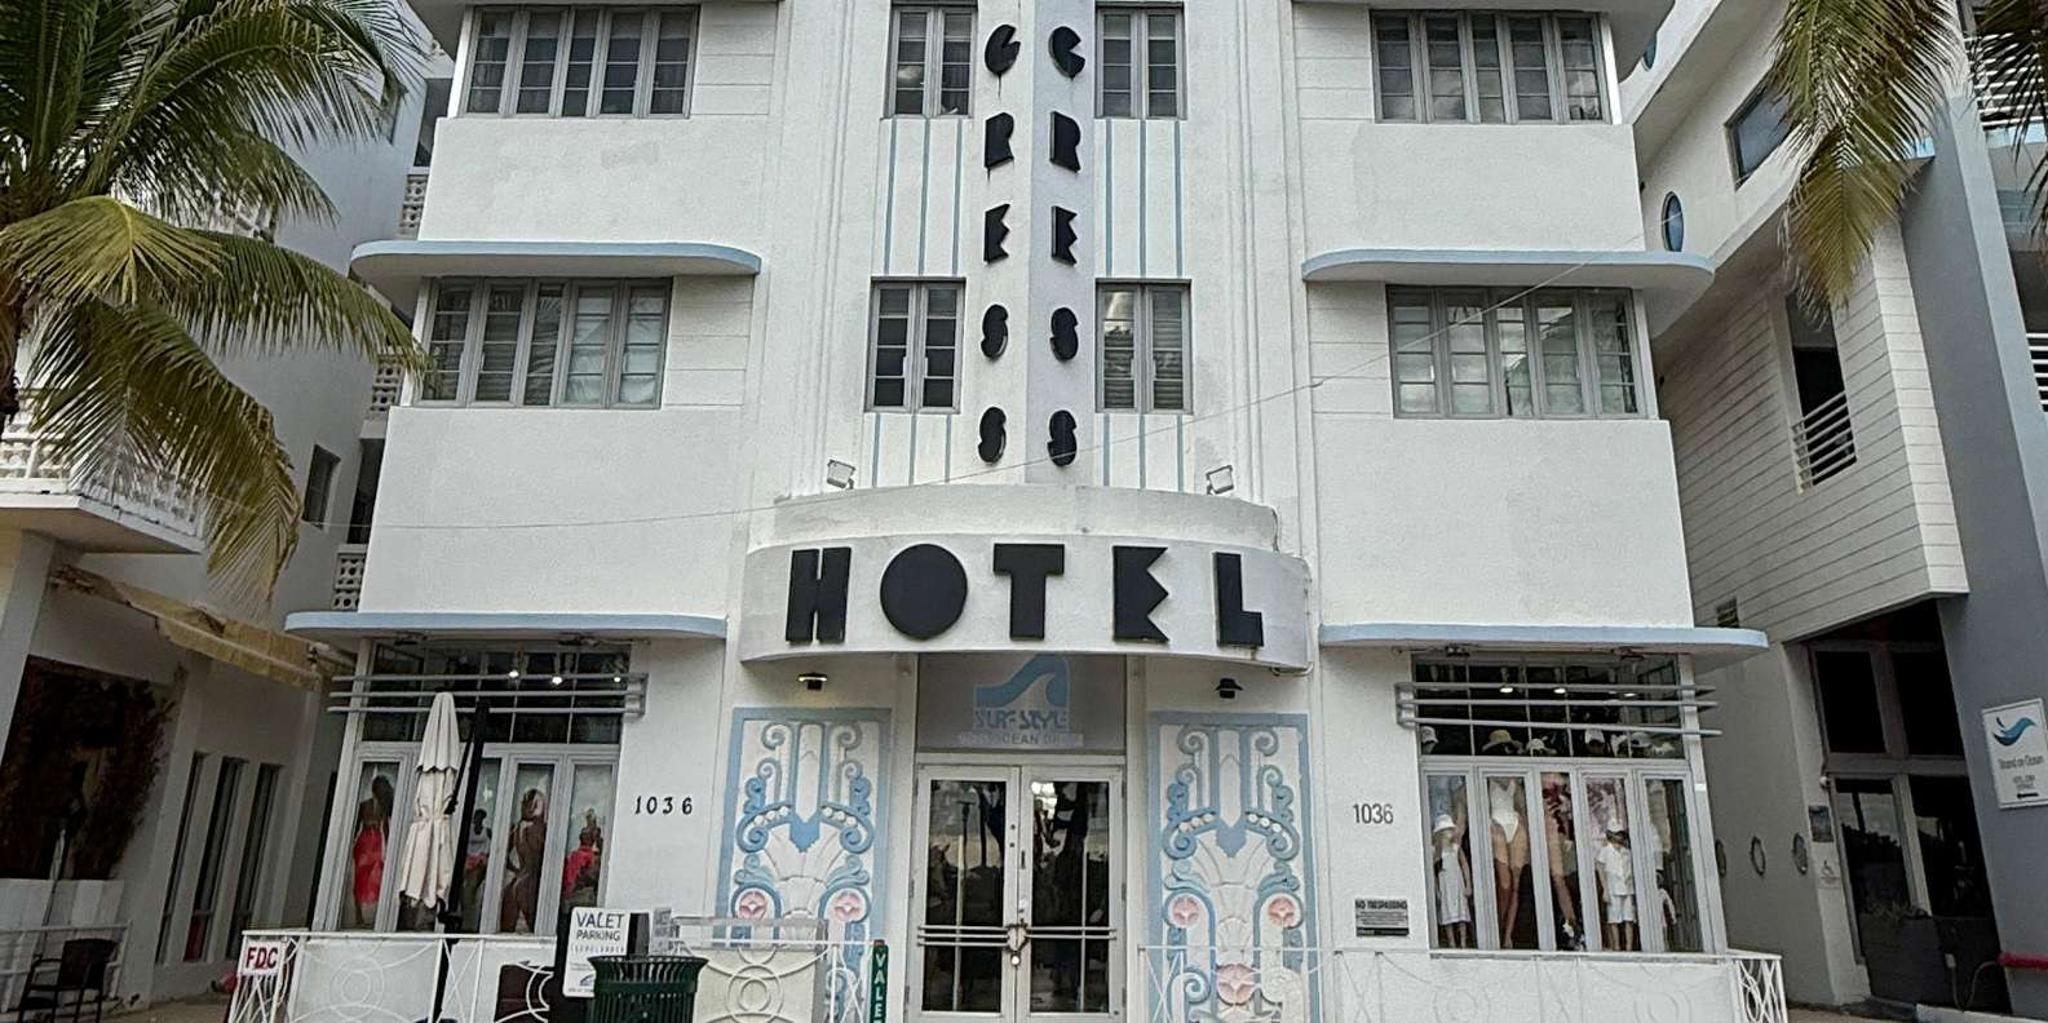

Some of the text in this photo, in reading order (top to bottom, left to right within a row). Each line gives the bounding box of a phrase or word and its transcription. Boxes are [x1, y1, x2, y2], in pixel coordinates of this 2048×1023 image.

[785, 542, 1264, 648] HOTEL
[635, 795, 693, 815] 1036
[1353, 803, 1394, 824] 1036
[576, 911, 625, 929] VALET
[576, 929, 621, 941] PARKING
[245, 946, 279, 969] FDC
